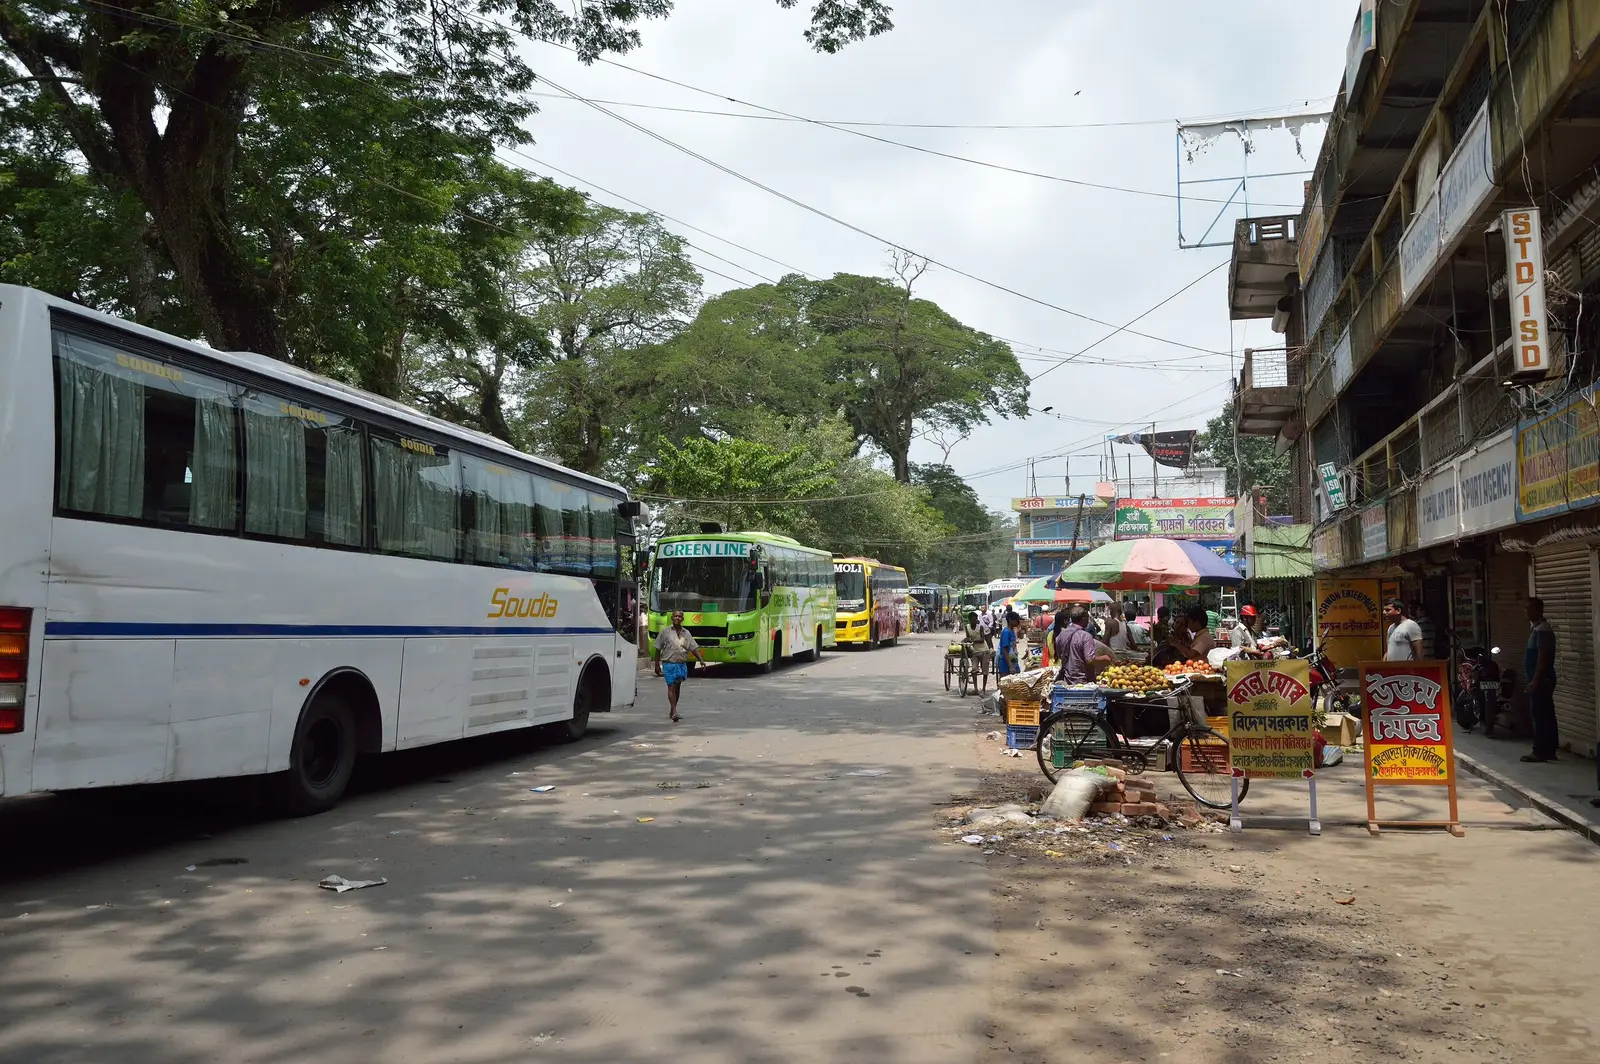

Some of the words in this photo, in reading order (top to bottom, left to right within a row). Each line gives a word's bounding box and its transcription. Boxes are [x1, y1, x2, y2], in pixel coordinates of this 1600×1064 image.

[1512, 213, 1540, 368] STD/ISD
[401, 437, 436, 456] SOUDIA
[1321, 465, 1336, 478] STD
[1482, 460, 1512, 506] AGENCY
[1326, 479, 1340, 491] ISD
[1330, 492, 1344, 505] PCO
[1155, 513, 1185, 532] শ্যামলী
[1187, 513, 1226, 532] পরিবহন
[663, 543, 713, 557] GREEN
[715, 543, 748, 556] LINE
[487, 588, 559, 618] Soudia
[1341, 589, 1378, 613] ENTERPRISE
[1227, 670, 1269, 706] কালু
[1267, 670, 1309, 706] ঘোষ
[1365, 673, 1442, 709] উত্তম
[1369, 705, 1442, 741] মিত্র
